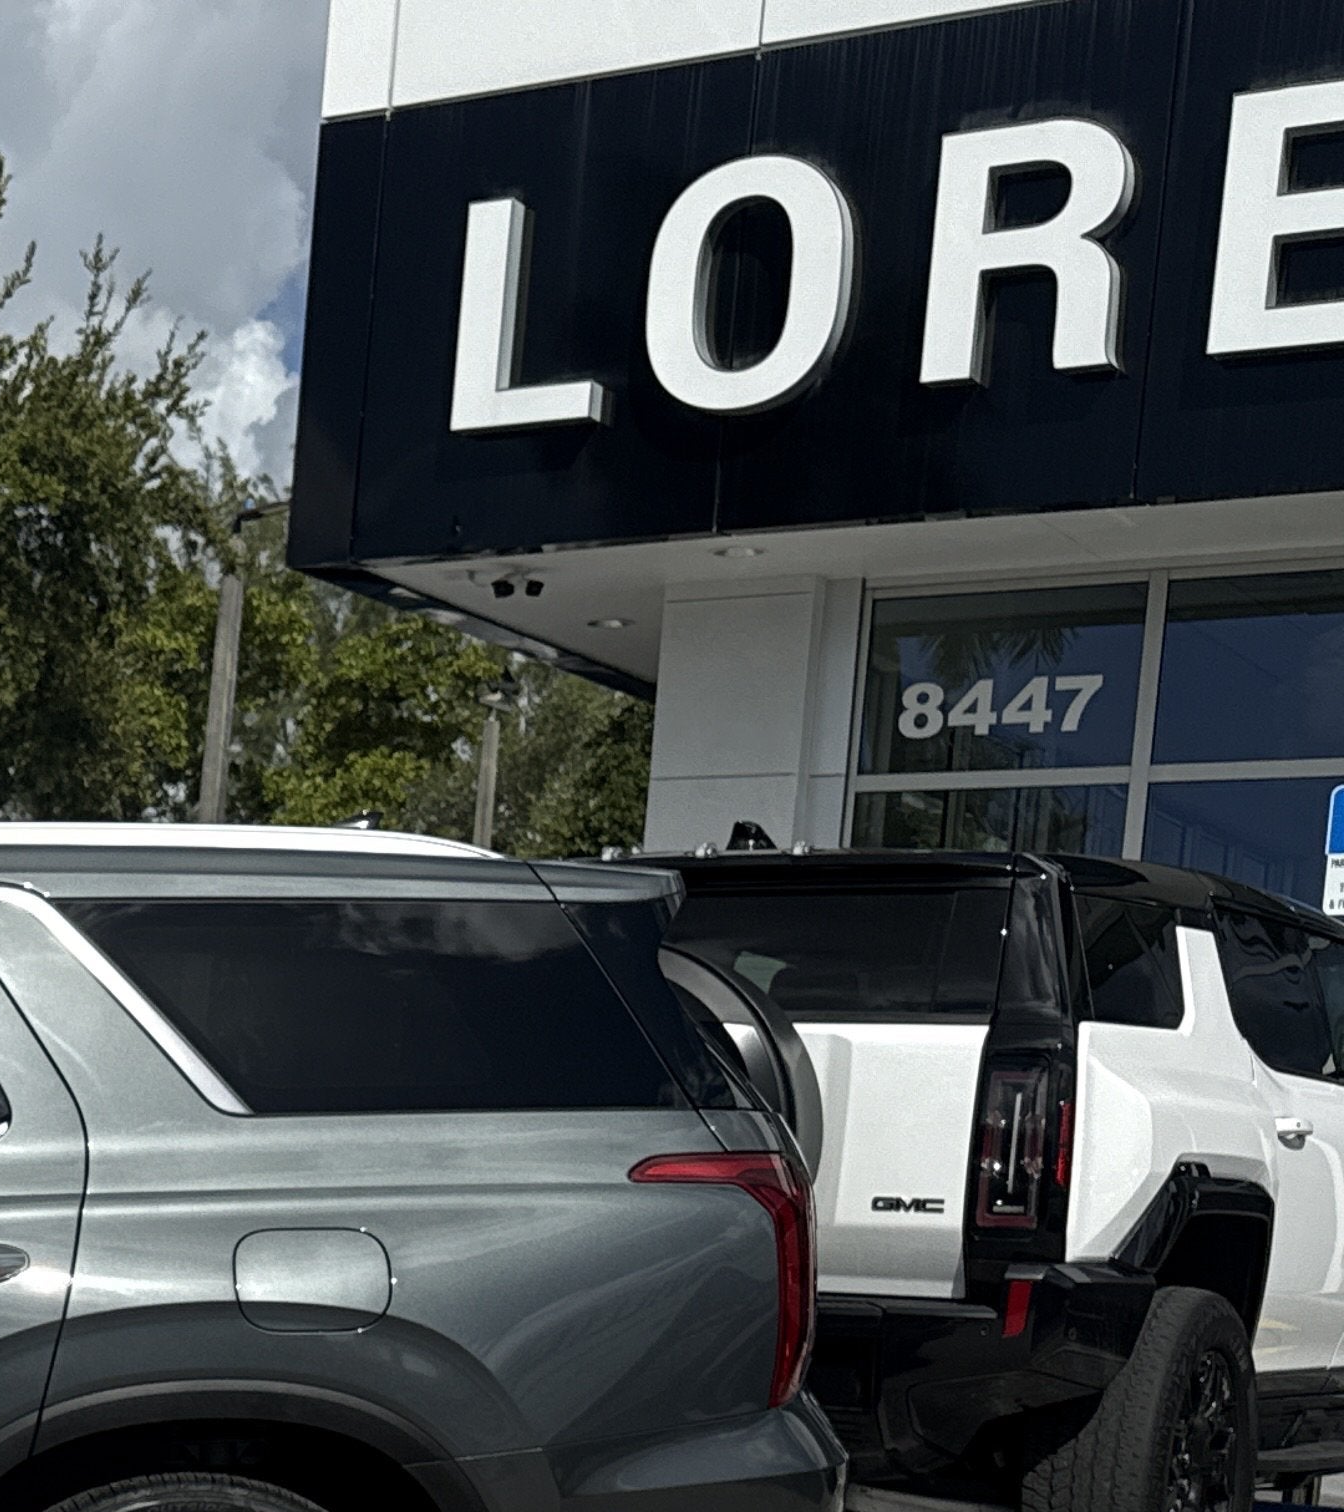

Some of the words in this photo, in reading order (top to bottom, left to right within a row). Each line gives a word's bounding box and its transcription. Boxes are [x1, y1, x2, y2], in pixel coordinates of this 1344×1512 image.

[449, 81, 1344, 433] LORE
[898, 674, 1104, 739] 8447
[871, 1197, 945, 1213] GMC
